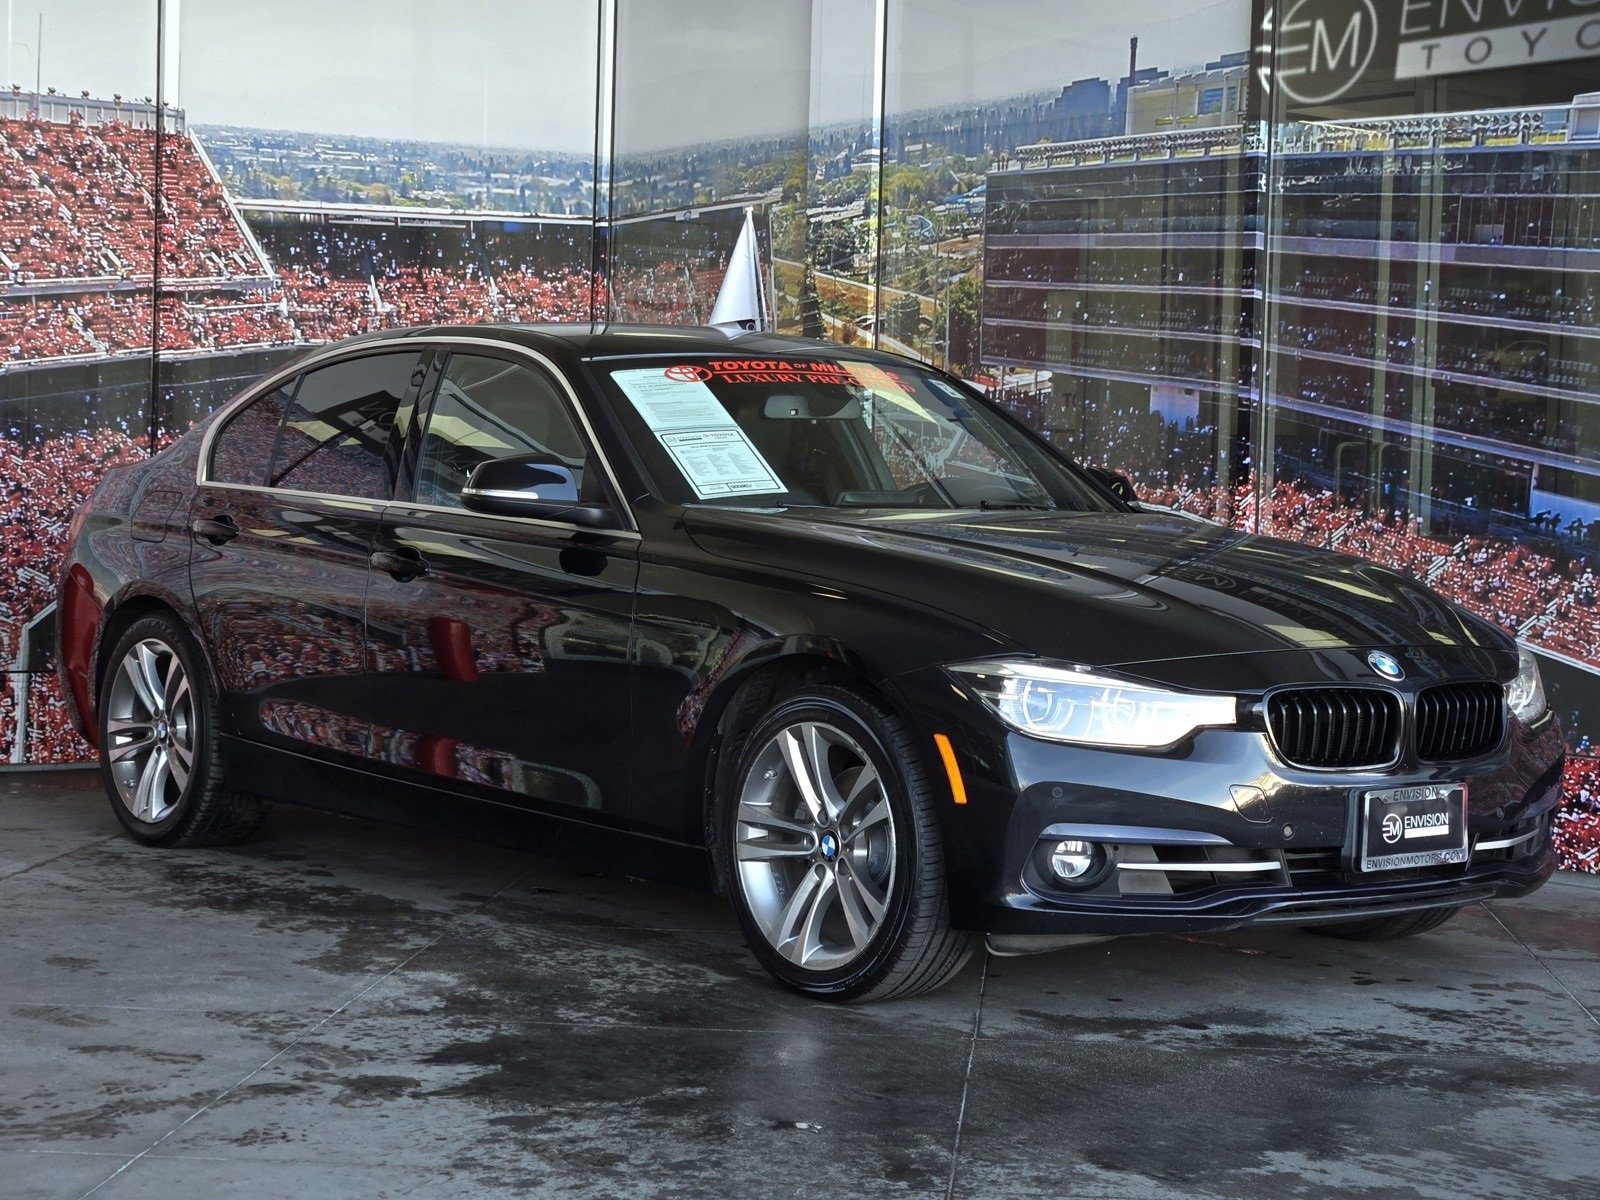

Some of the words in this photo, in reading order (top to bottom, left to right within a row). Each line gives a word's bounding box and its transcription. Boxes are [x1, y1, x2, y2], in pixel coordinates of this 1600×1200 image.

[1421, 18, 1600, 70] TOYO
[708, 361, 793, 371] TOYOTA
[721, 373, 805, 384] LUXURY
[1393, 786, 1438, 801] ENVISION
[1382, 817, 1401, 840] EM
[1404, 812, 1449, 829] ENVISION
[1366, 850, 1464, 870] ENVISIONMOTORS.COM
